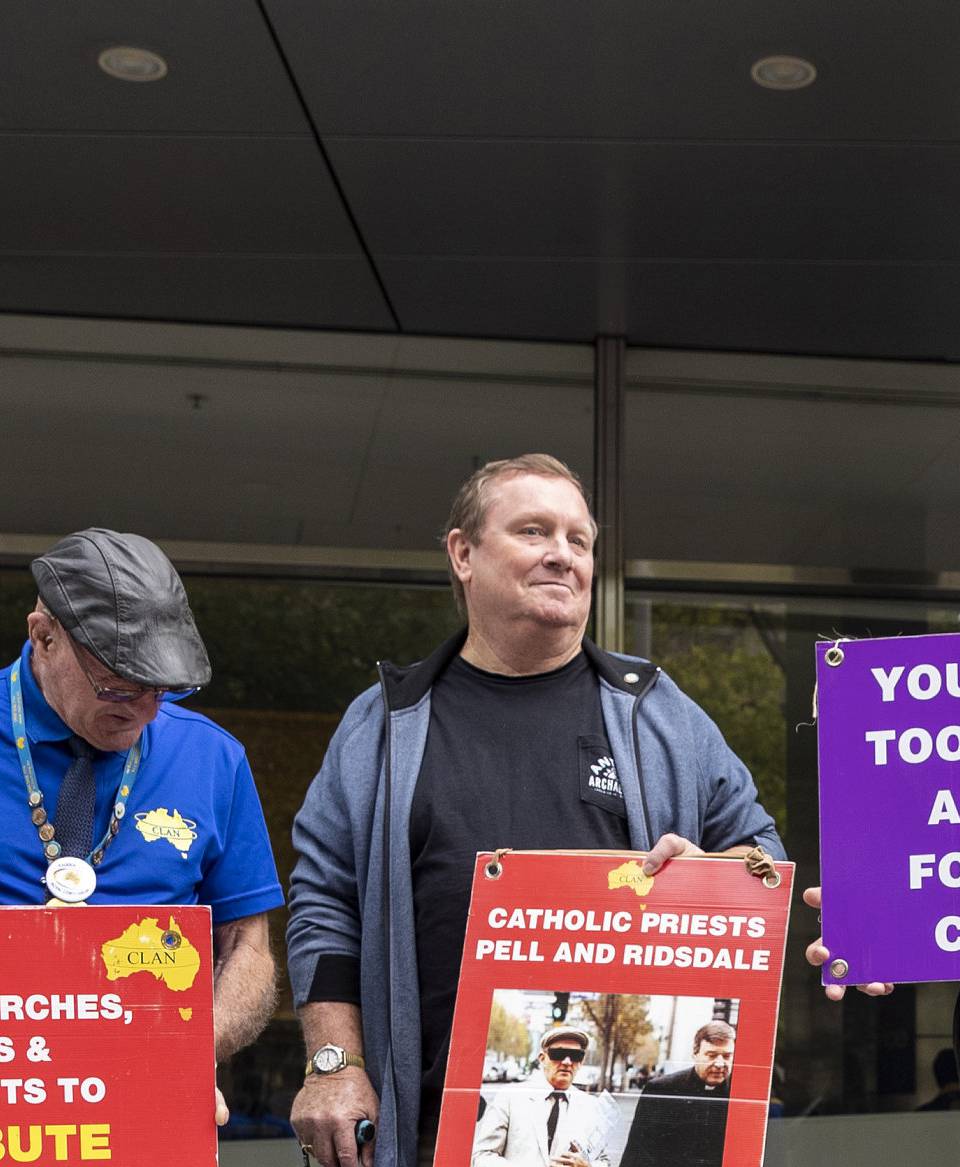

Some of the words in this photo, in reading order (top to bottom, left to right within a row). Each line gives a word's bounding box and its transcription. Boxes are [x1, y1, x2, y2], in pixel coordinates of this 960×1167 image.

[152, 827, 180, 838] CLAN
[488, 907, 632, 933] CATHOLIC
[640, 912, 766, 938] PRIESTS
[127, 951, 177, 966] CLAN
[475, 939, 545, 962] PELL
[552, 941, 616, 964] AND
[622, 944, 770, 971] RIDSDALE
[26, 1036, 52, 1062] &
[57, 1076, 106, 1103] TO
[0, 1123, 112, 1162] UTE
